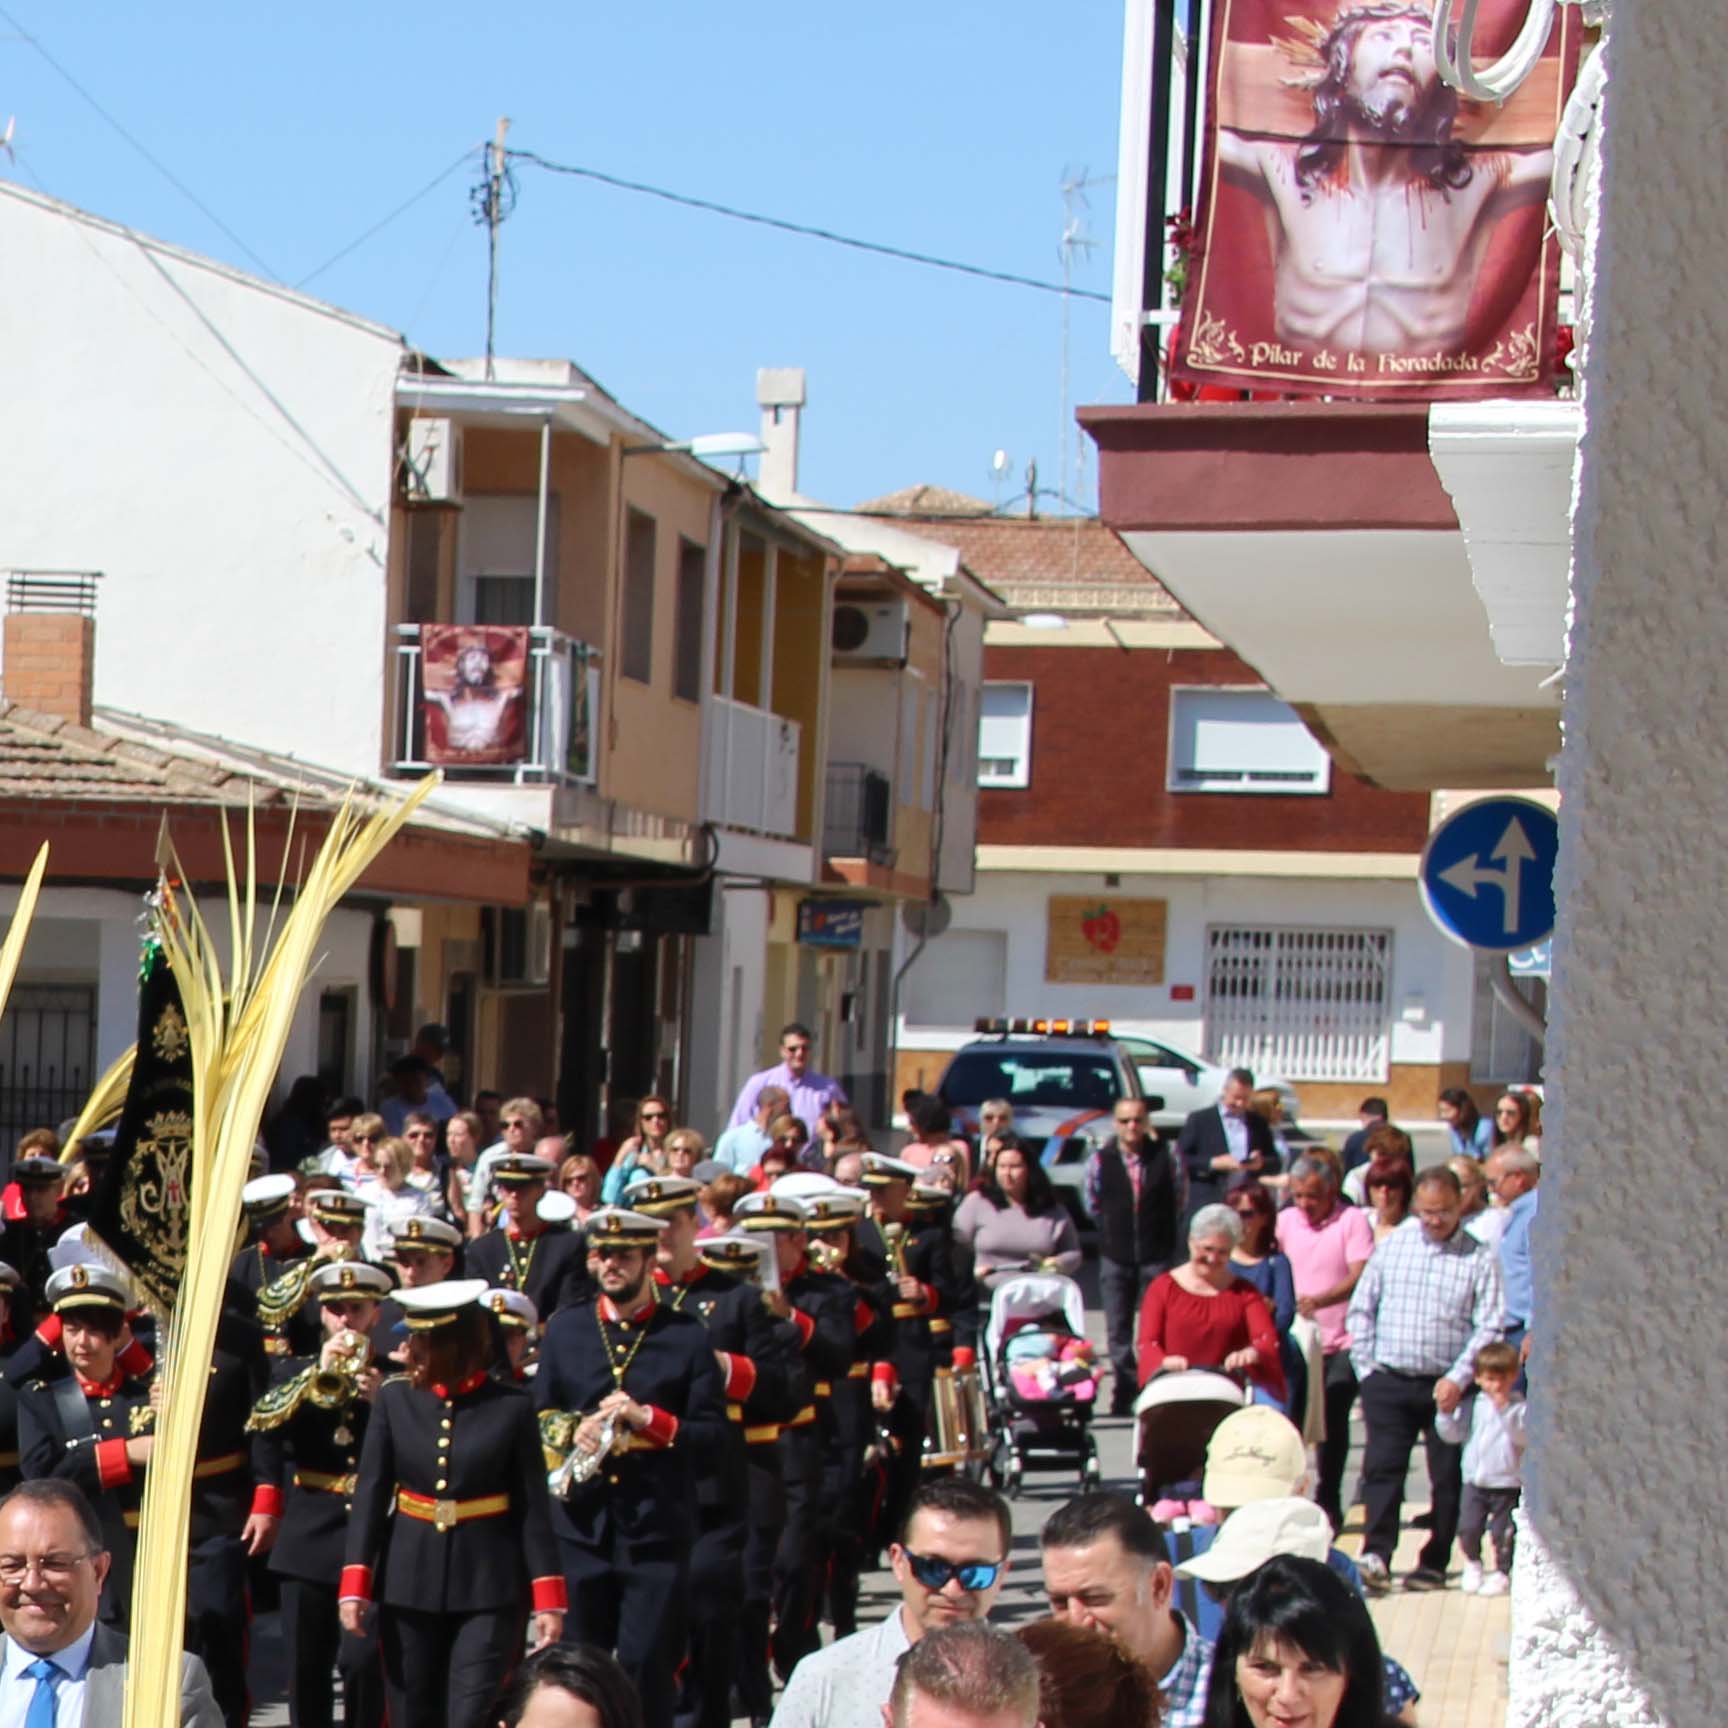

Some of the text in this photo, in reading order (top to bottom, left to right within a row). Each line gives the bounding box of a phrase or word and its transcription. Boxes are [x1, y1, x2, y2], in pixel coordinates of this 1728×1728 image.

[1248, 341, 1302, 367] Pilar
[1312, 349, 1337, 371] de
[1347, 351, 1366, 373] la
